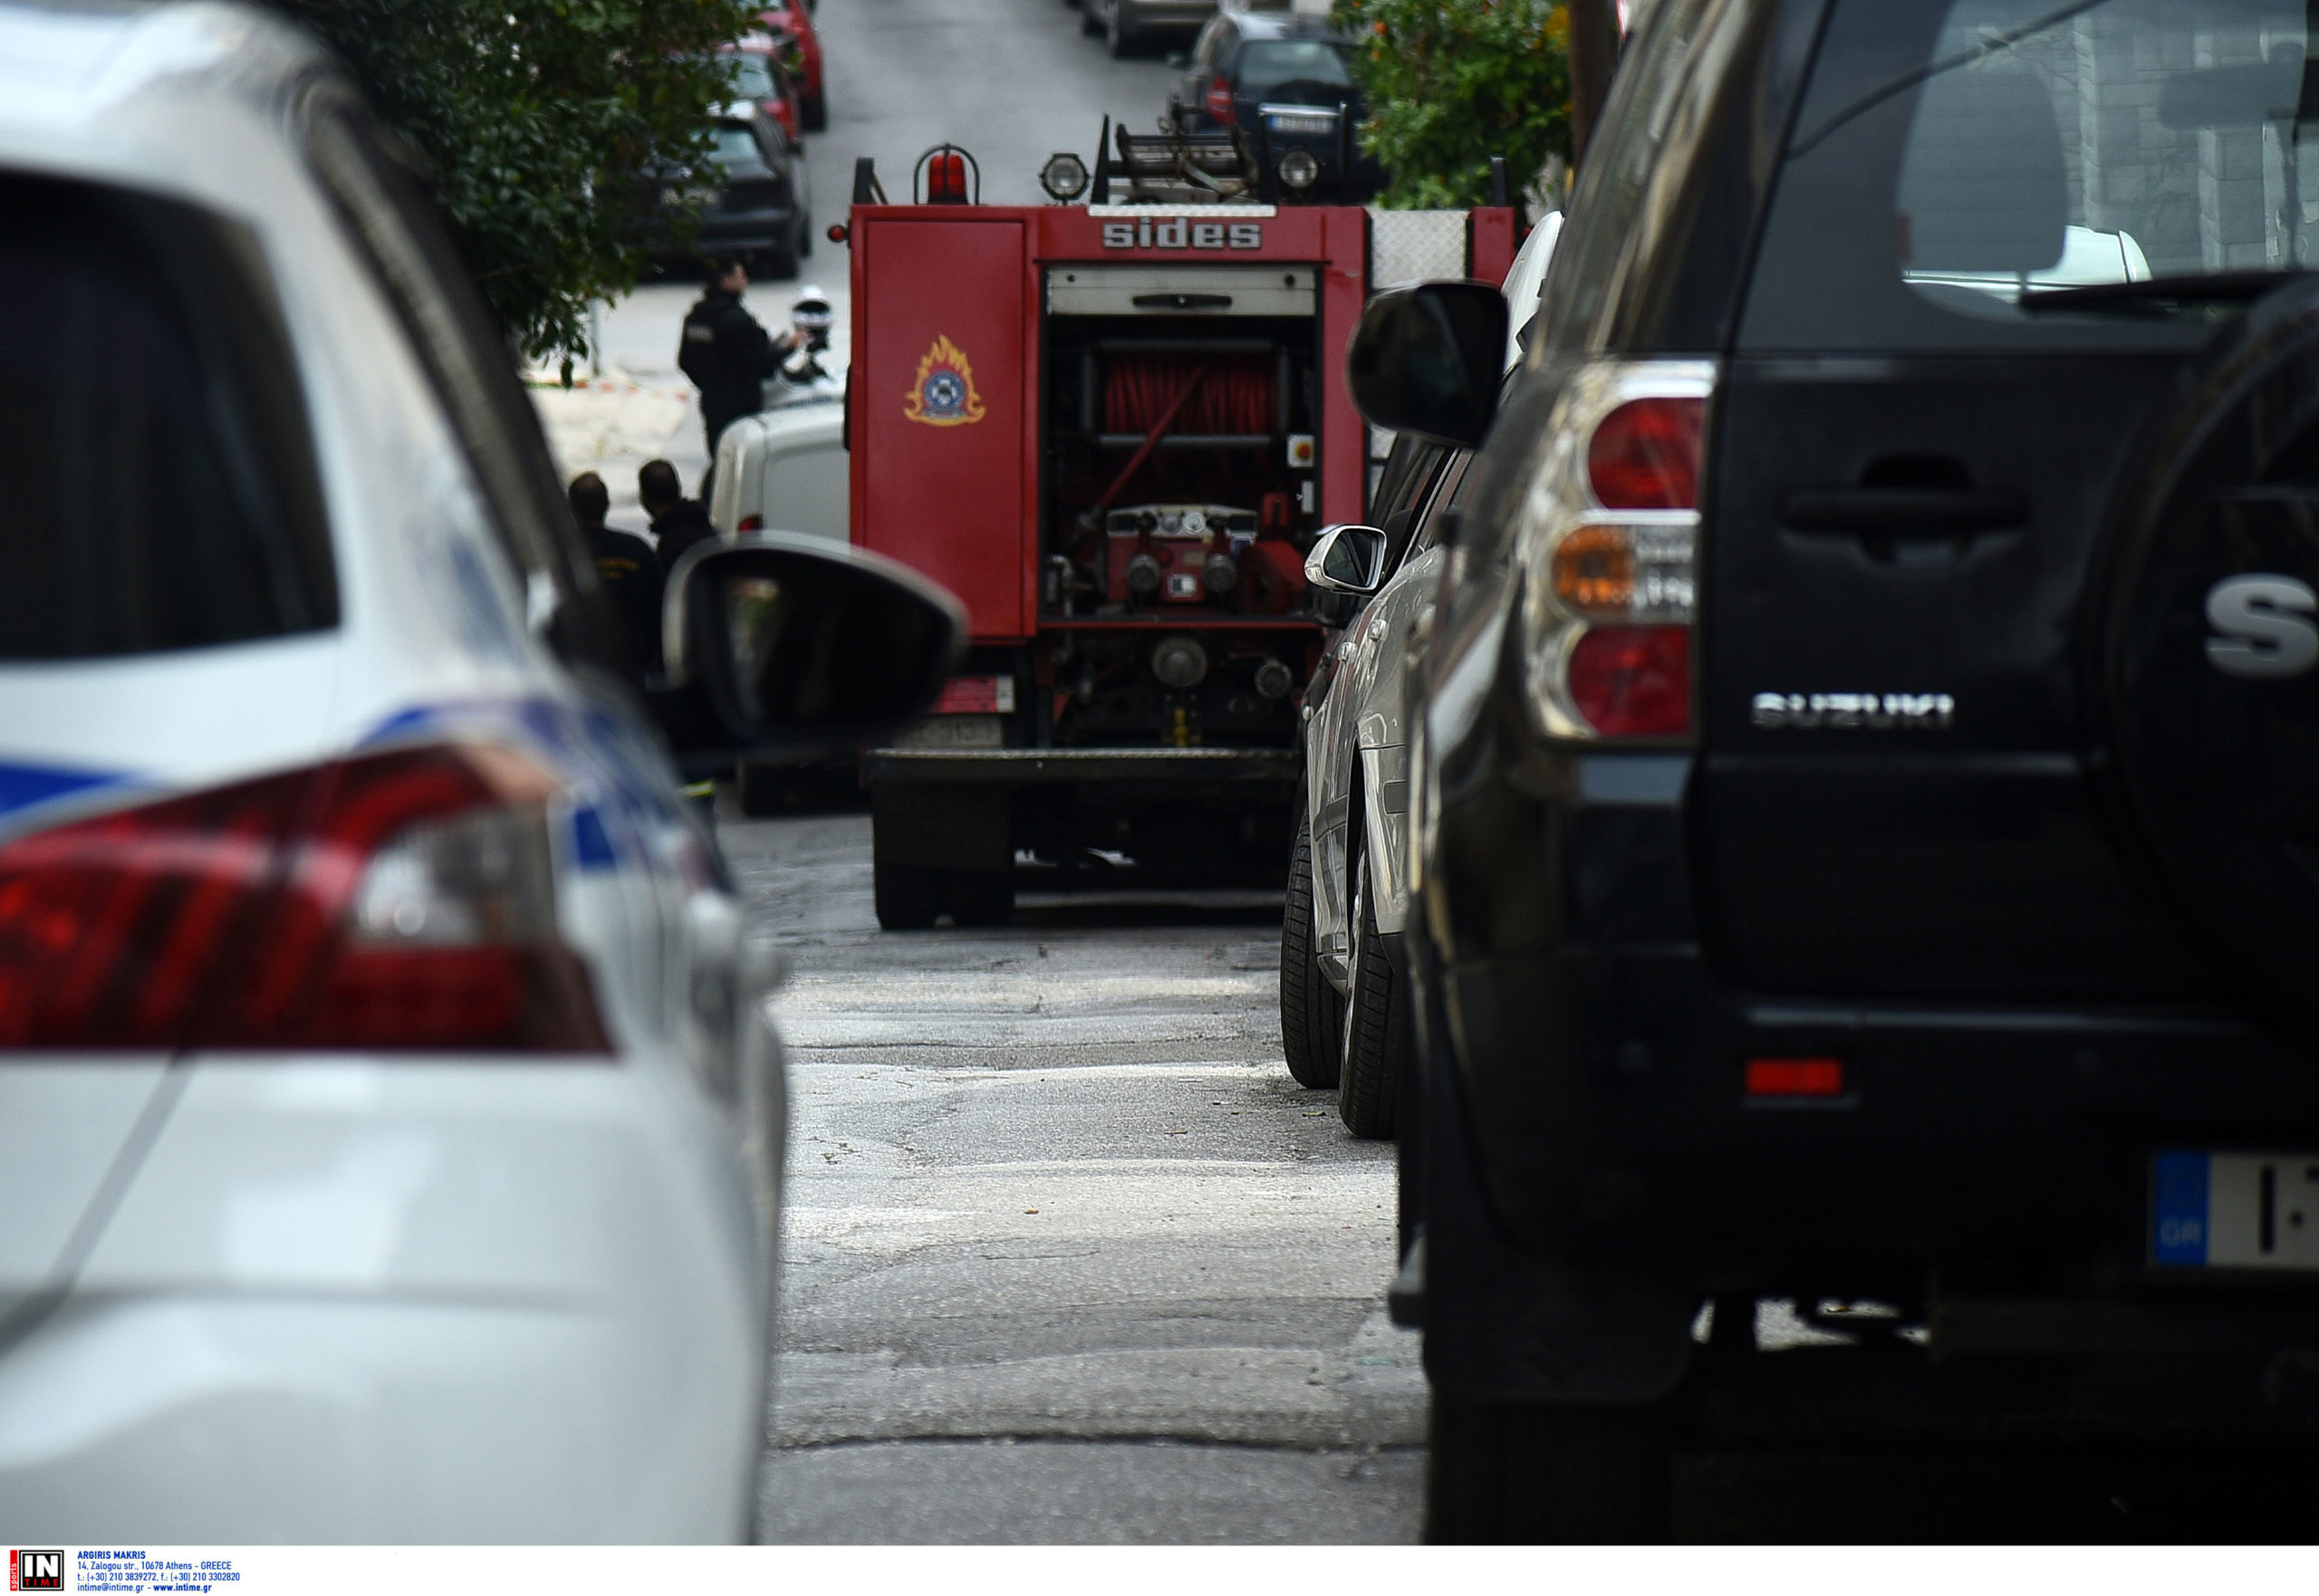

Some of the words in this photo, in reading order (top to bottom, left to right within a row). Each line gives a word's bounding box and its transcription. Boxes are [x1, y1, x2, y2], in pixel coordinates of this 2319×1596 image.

[1104, 216, 1261, 249] sides
[1752, 692, 1956, 730] SUZUKI
[2160, 1218, 2203, 1248] GR
